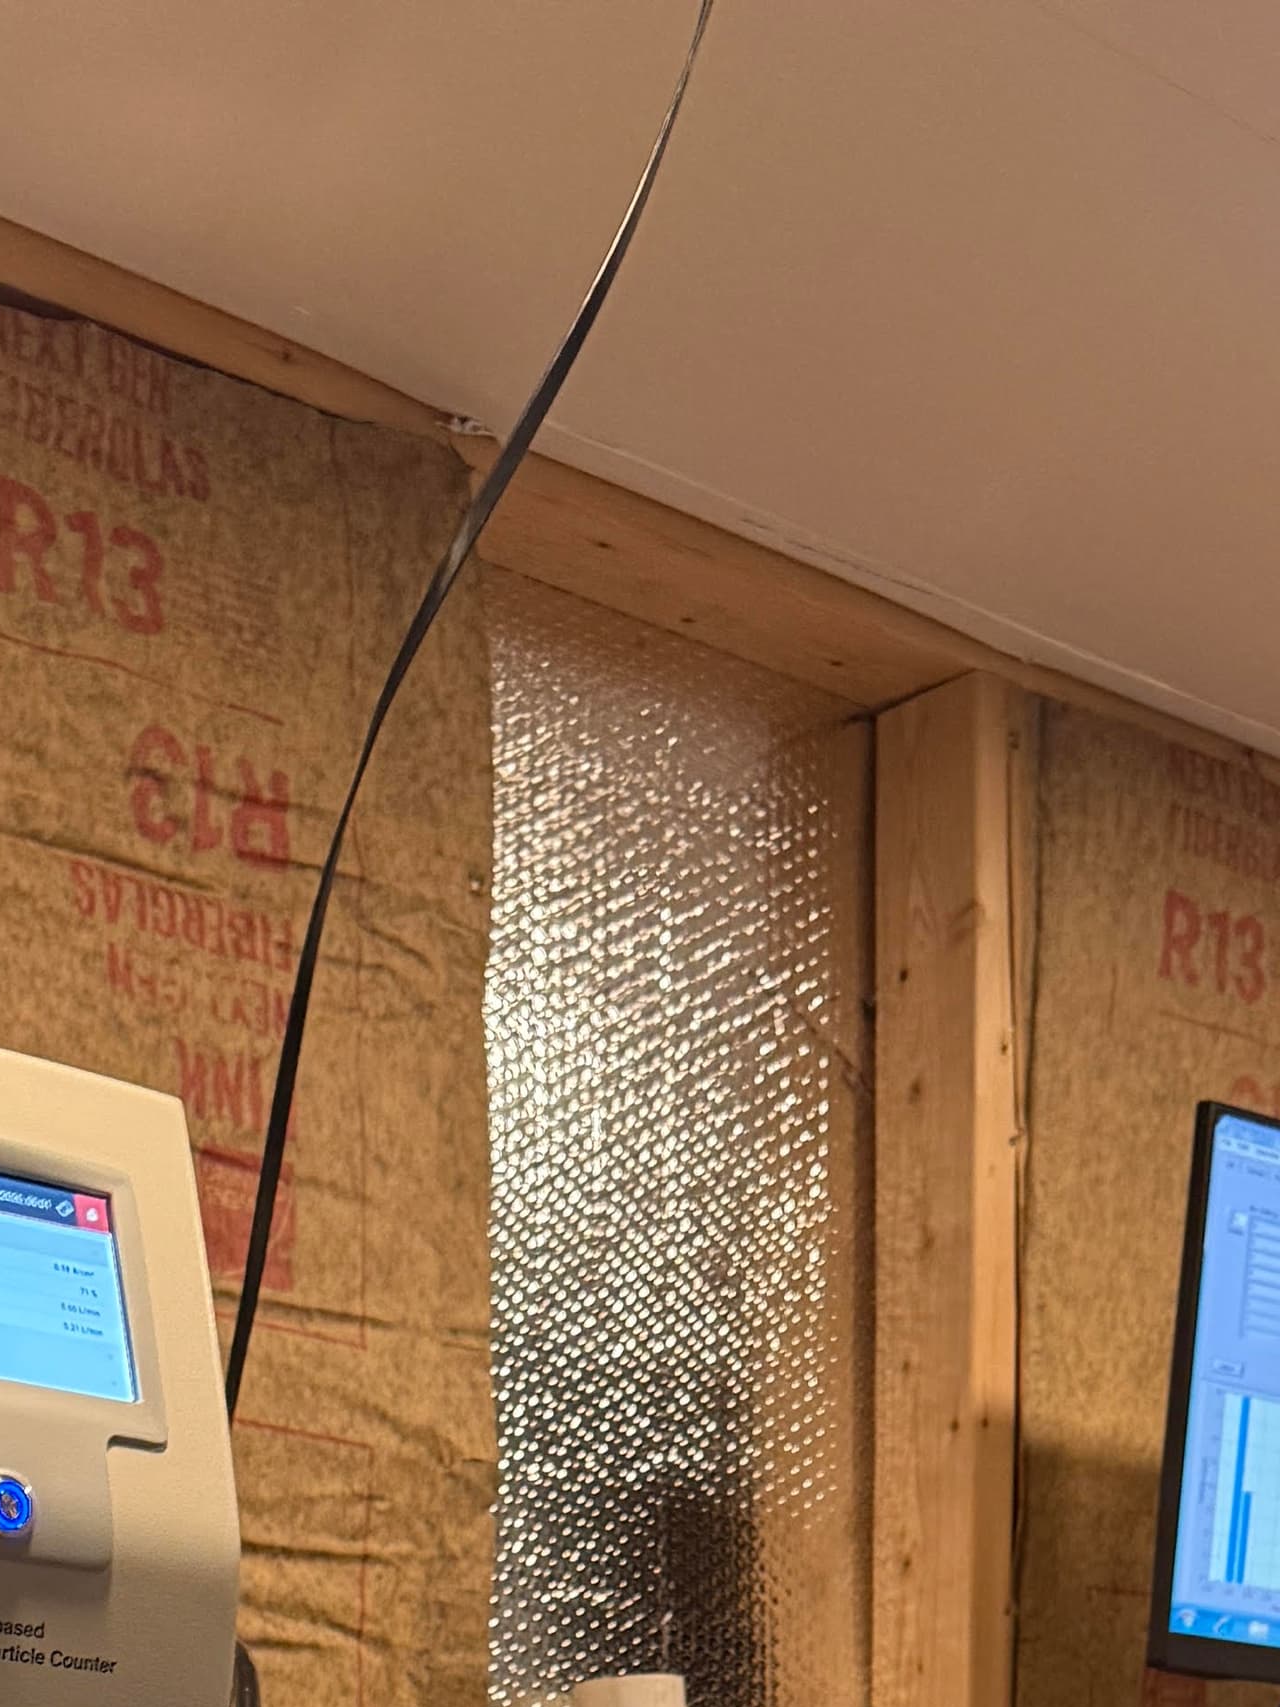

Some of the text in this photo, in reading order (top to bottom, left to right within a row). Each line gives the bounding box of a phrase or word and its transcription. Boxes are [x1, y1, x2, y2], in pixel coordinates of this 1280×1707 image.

[128, 725, 291, 872] R13
[69, 860, 293, 971] FIBERGLAS
[1158, 889, 1266, 1005] R13
[173, 1039, 294, 1138] INK
[50, 1650, 117, 1675] Counter
